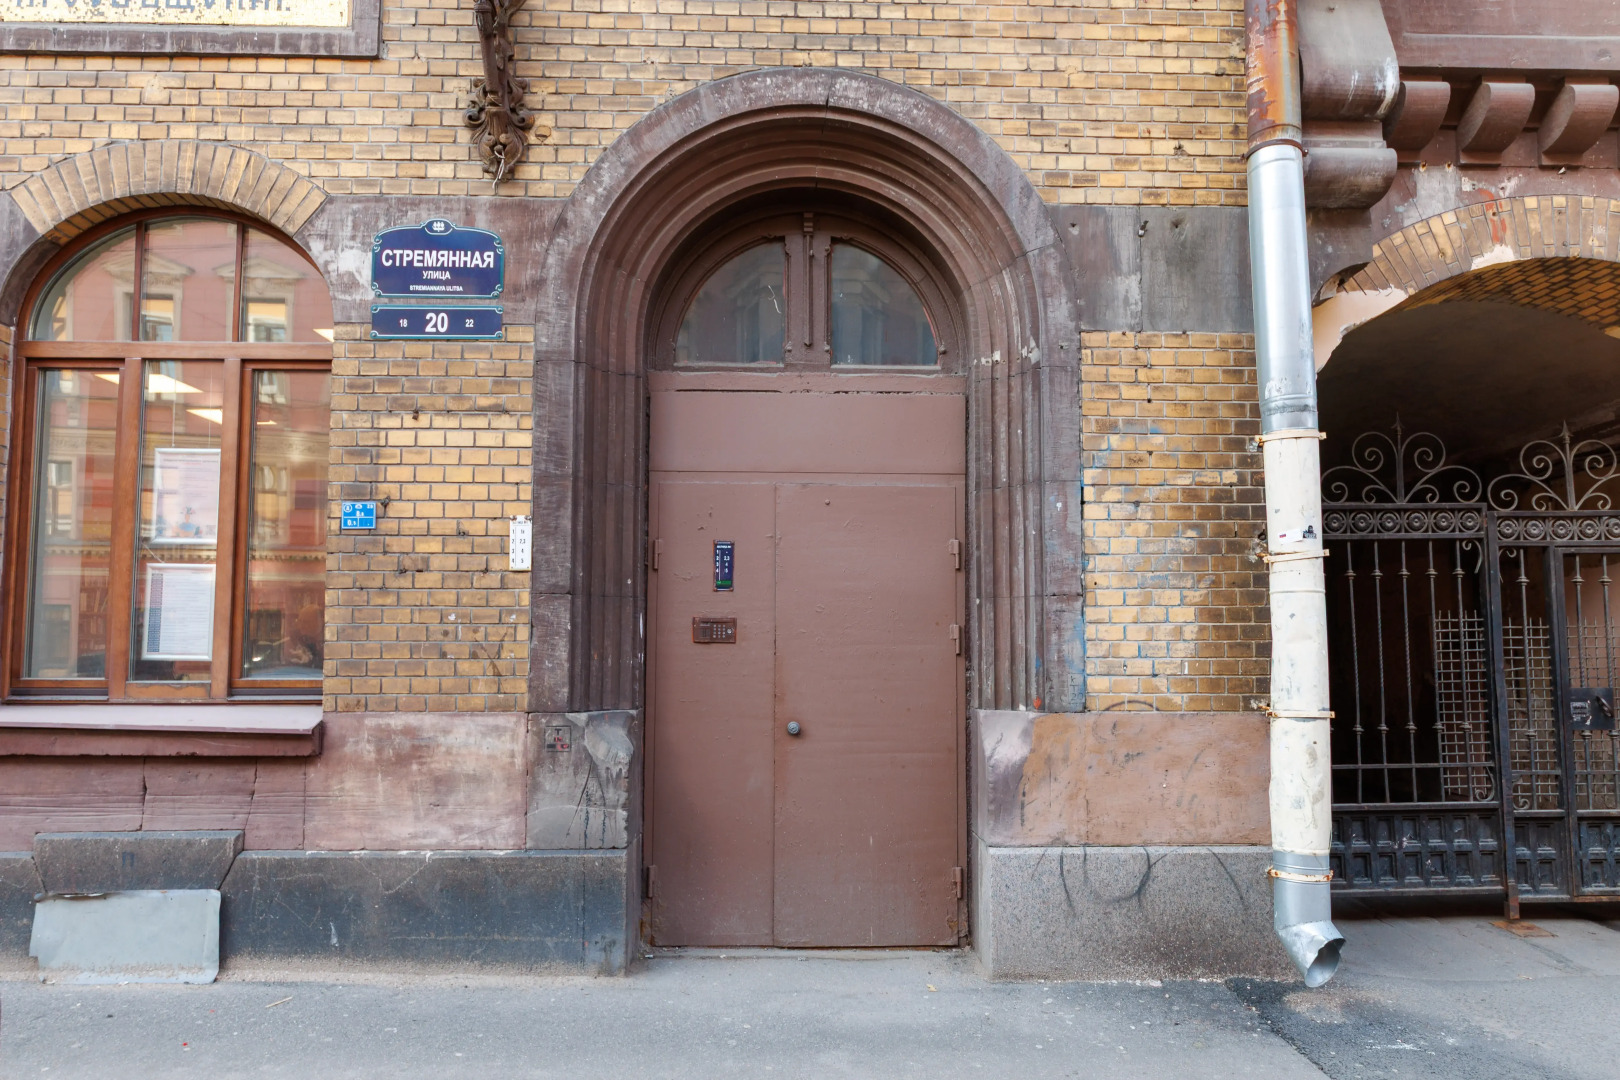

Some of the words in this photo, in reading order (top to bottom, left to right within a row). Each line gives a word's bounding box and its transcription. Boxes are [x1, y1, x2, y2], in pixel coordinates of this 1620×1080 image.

[381, 249, 494, 268] СТРЕМЯННАЯ
[422, 270, 451, 280] УЛИЦА
[400, 319, 408, 328] 18
[425, 312, 449, 333] 20
[465, 319, 474, 328] 22
